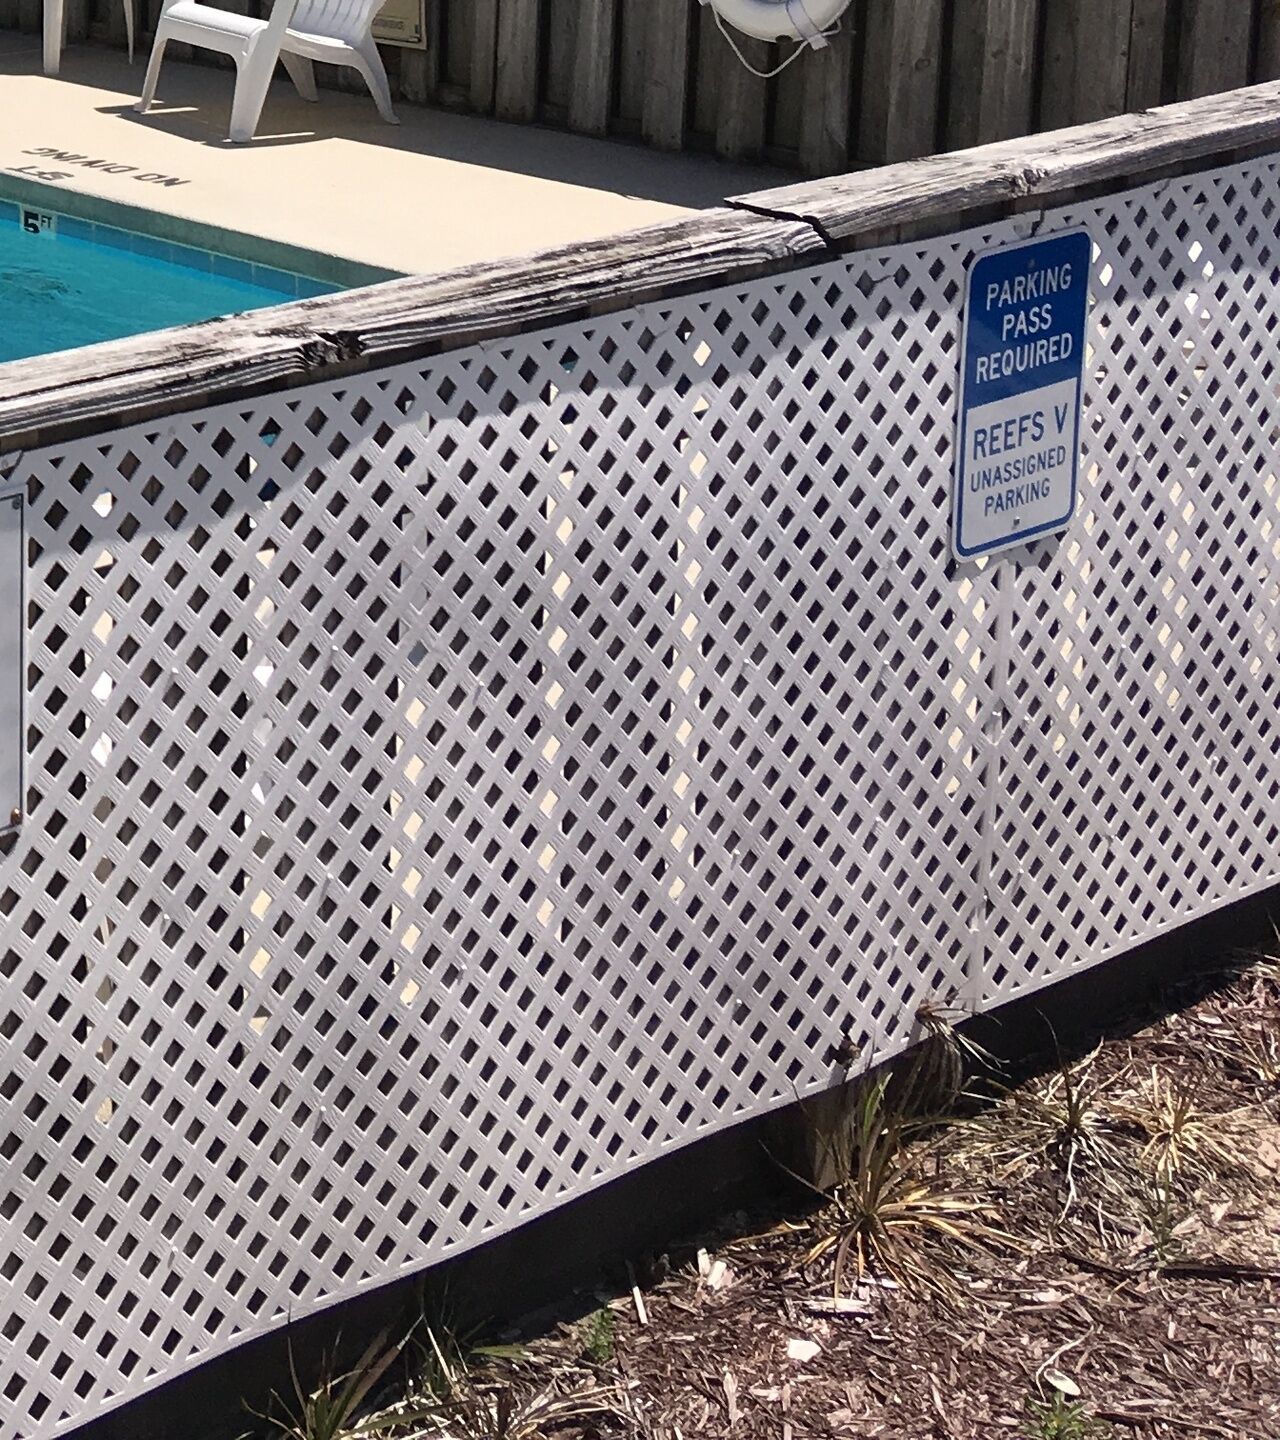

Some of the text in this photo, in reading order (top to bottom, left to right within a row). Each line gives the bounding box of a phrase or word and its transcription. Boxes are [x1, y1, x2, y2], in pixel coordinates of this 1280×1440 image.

[20, 147, 192, 188] NO DIVING
[986, 263, 1072, 312] PARKING
[1002, 303, 1052, 342] PASS
[975, 332, 1073, 384] REQUIRED
[972, 402, 1068, 461] REEFS V
[970, 445, 1067, 493] UNASSIGNED
[984, 477, 1051, 517] PARKING
